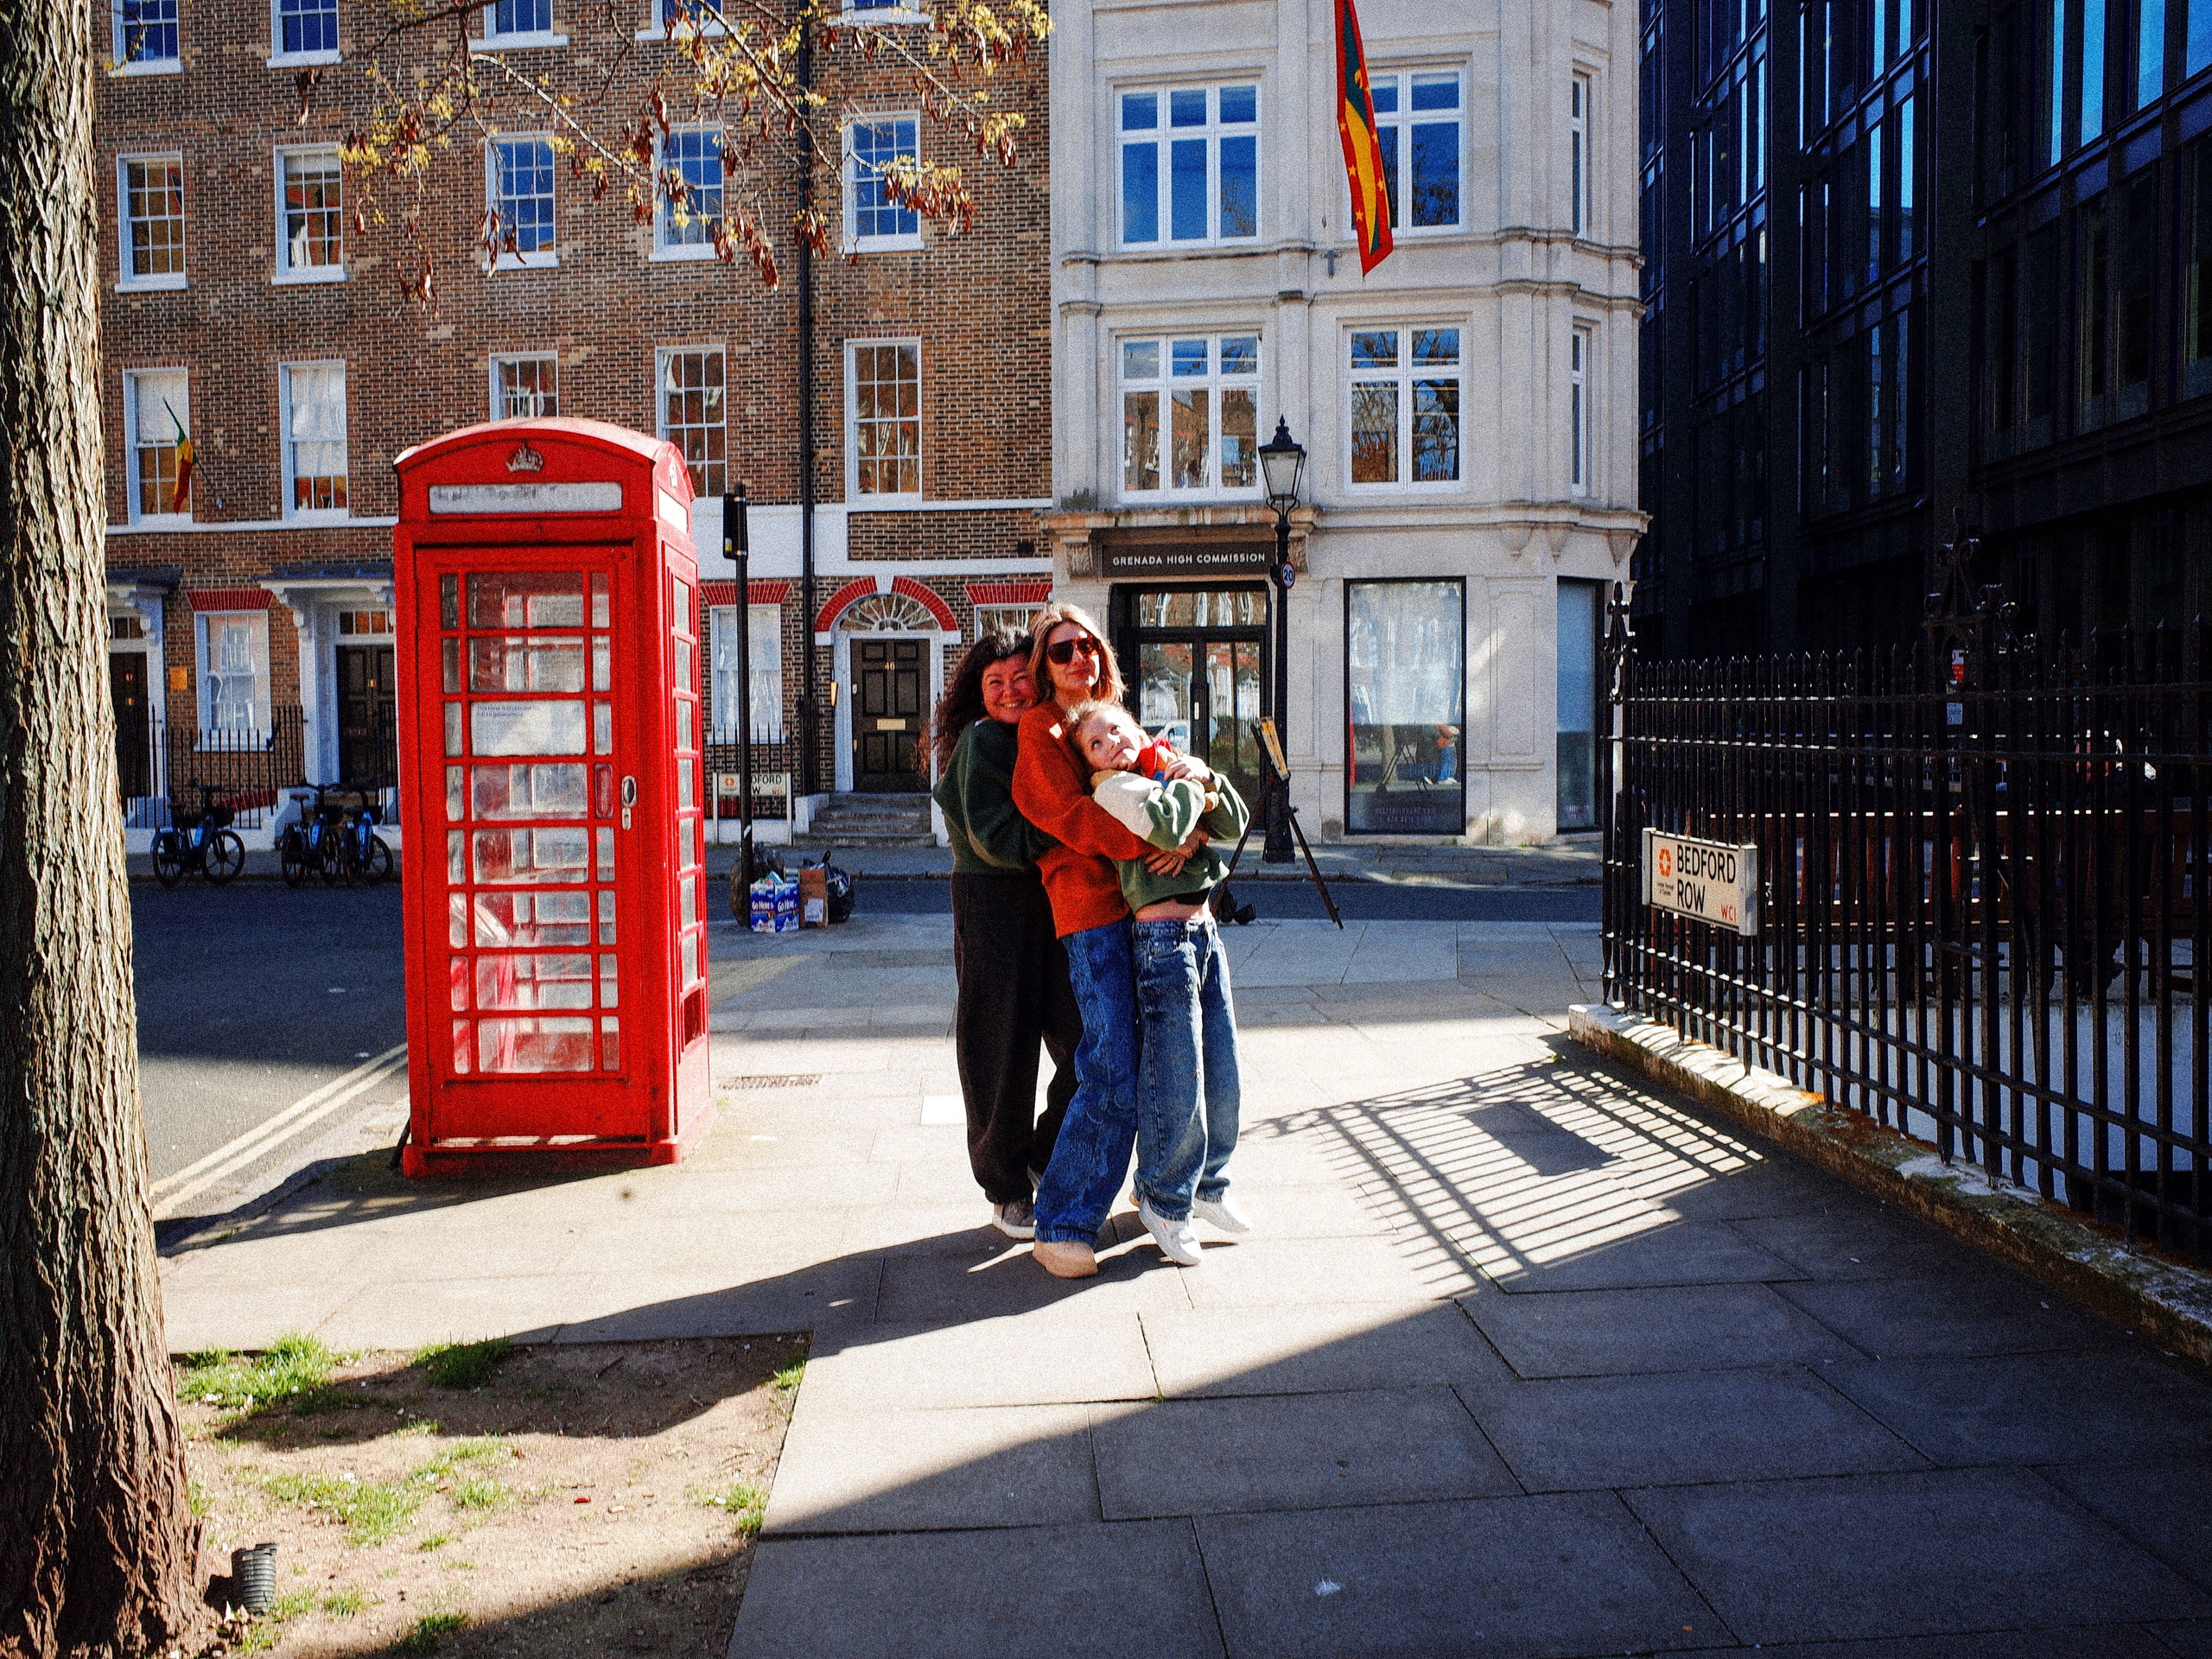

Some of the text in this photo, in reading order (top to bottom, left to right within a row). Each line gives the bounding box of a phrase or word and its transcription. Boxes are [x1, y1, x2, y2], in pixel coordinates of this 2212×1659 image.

[1112, 552, 1266, 566] GRENADA HIGH COMMISSION
[1284, 569, 1294, 582] 20
[884, 661, 895, 671] 40
[752, 774, 782, 785] DFORD
[1677, 844, 1736, 884] BEDFORD
[1677, 879, 1706, 913] ROW
